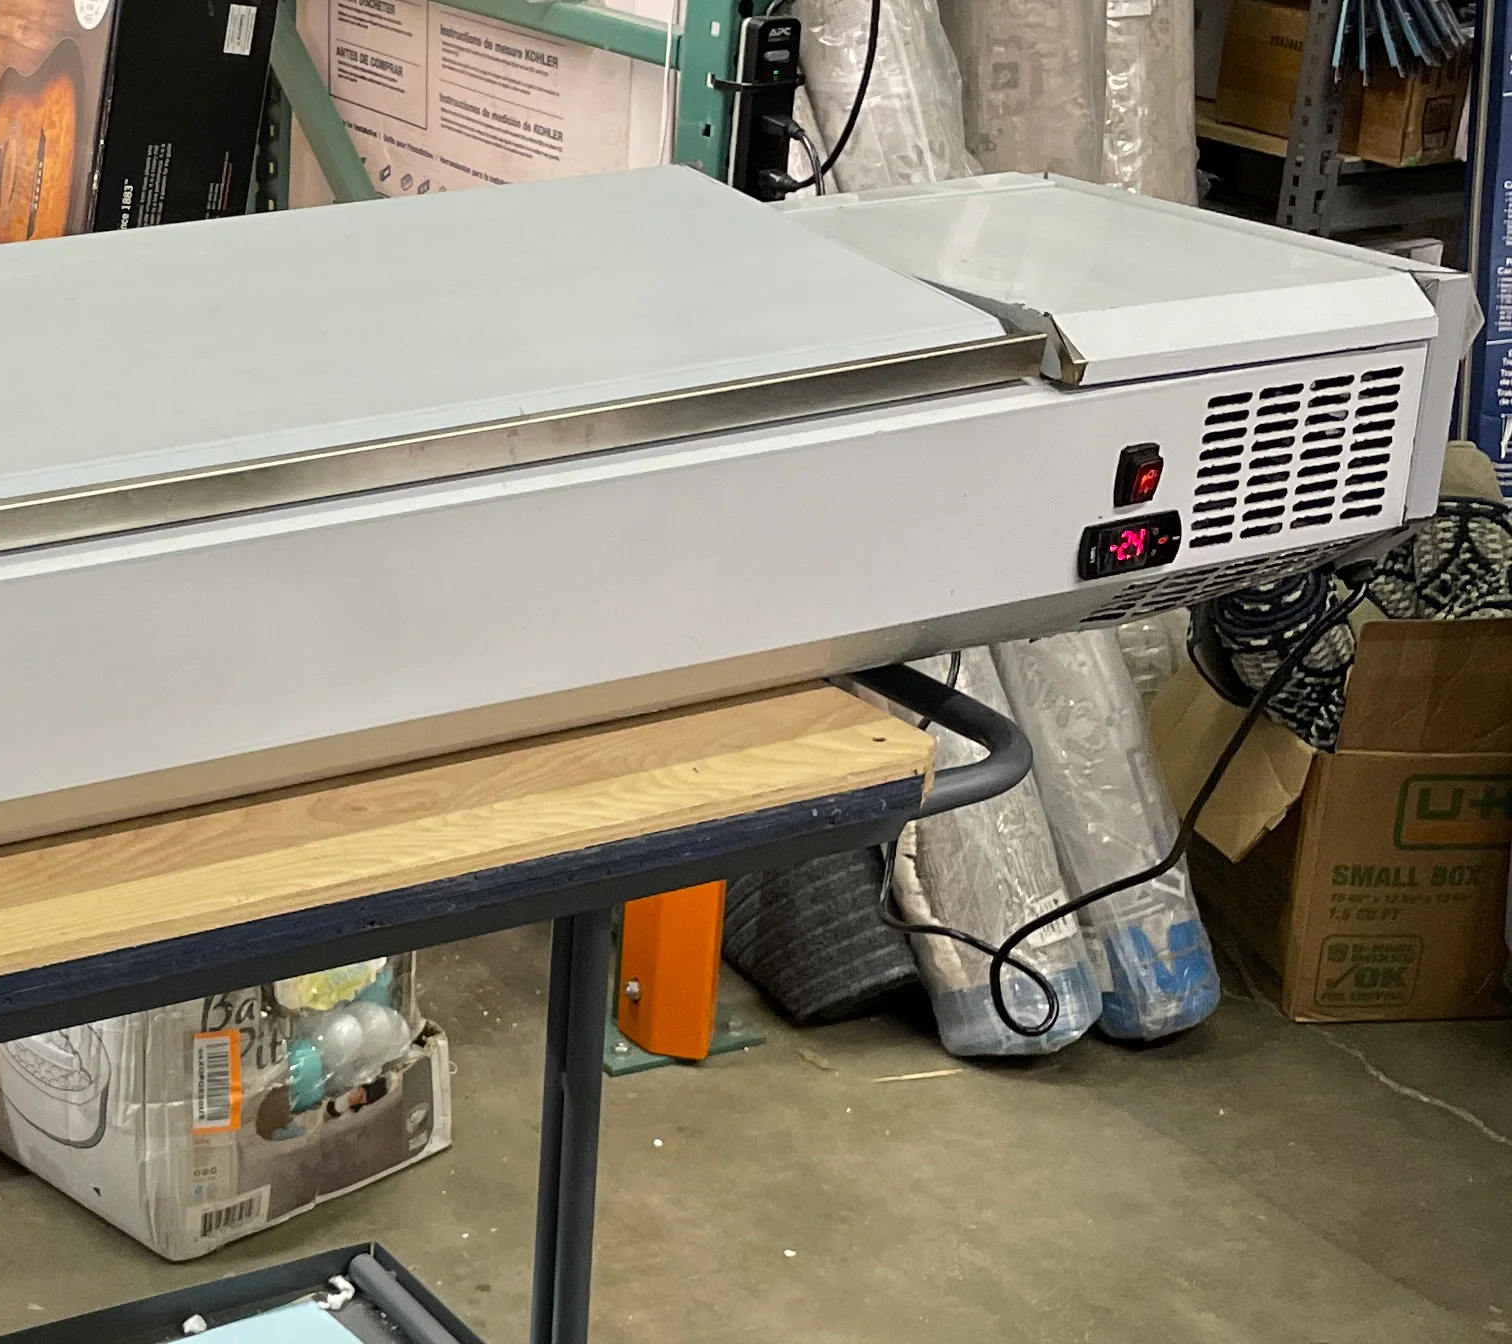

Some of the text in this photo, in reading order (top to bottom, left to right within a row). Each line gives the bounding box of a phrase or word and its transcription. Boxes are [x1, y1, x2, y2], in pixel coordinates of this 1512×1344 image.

[769, 26, 792, 37] APC
[524, 48, 559, 69] KOHLER
[533, 123, 564, 143] KOHLER
[1332, 864, 1484, 887] SMALL BOX
[201, 992, 258, 1033] Ba
